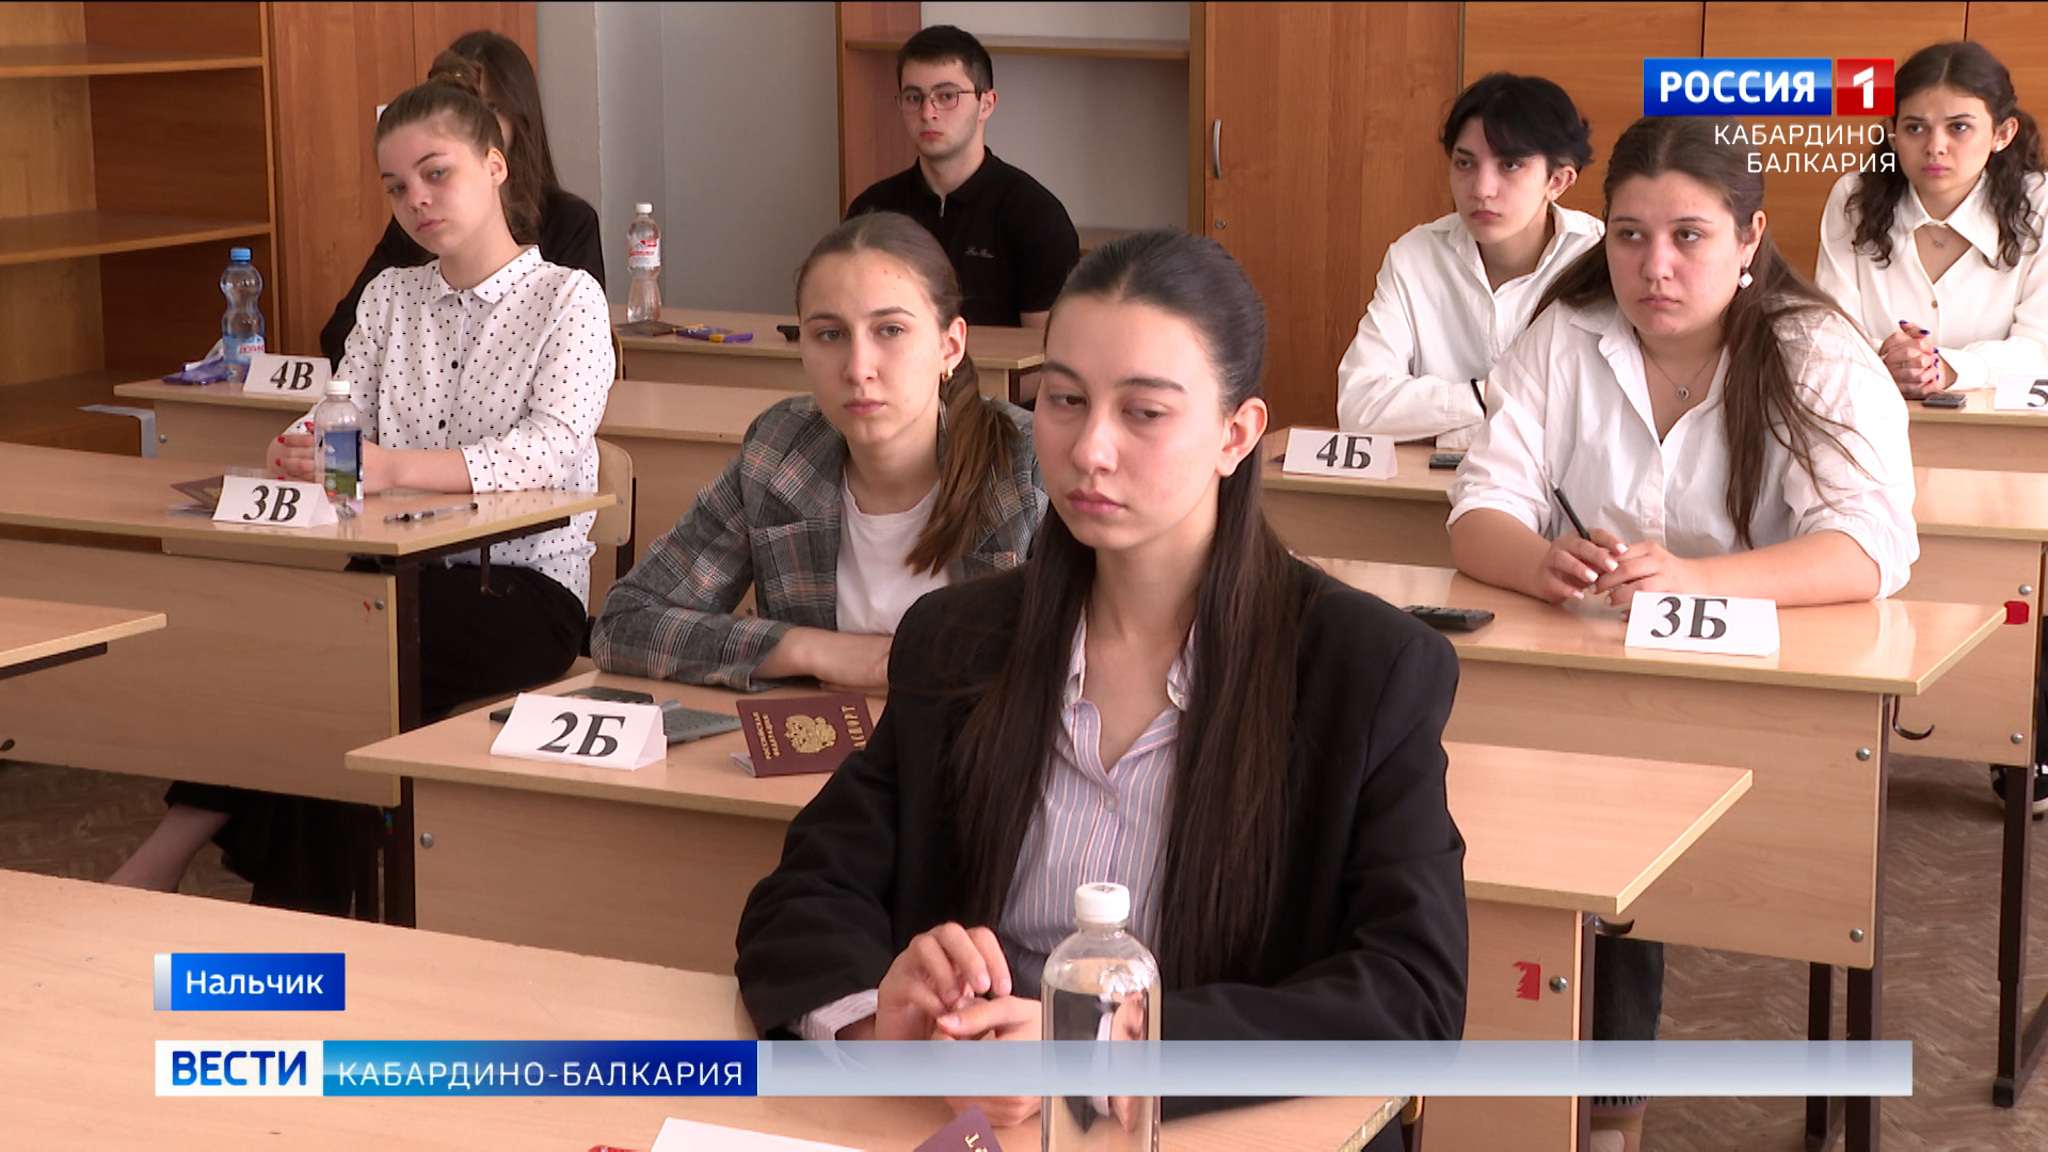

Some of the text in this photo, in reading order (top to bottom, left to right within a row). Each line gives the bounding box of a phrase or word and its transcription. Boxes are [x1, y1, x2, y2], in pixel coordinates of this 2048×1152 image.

[270, 360, 314, 391] 4В
[1316, 434, 1373, 470] 4Б
[243, 485, 301, 523] 3В
[1650, 595, 1728, 641] 3Б
[538, 711, 626, 757] 2Б
[841, 705, 867, 748] АСПОРТ
